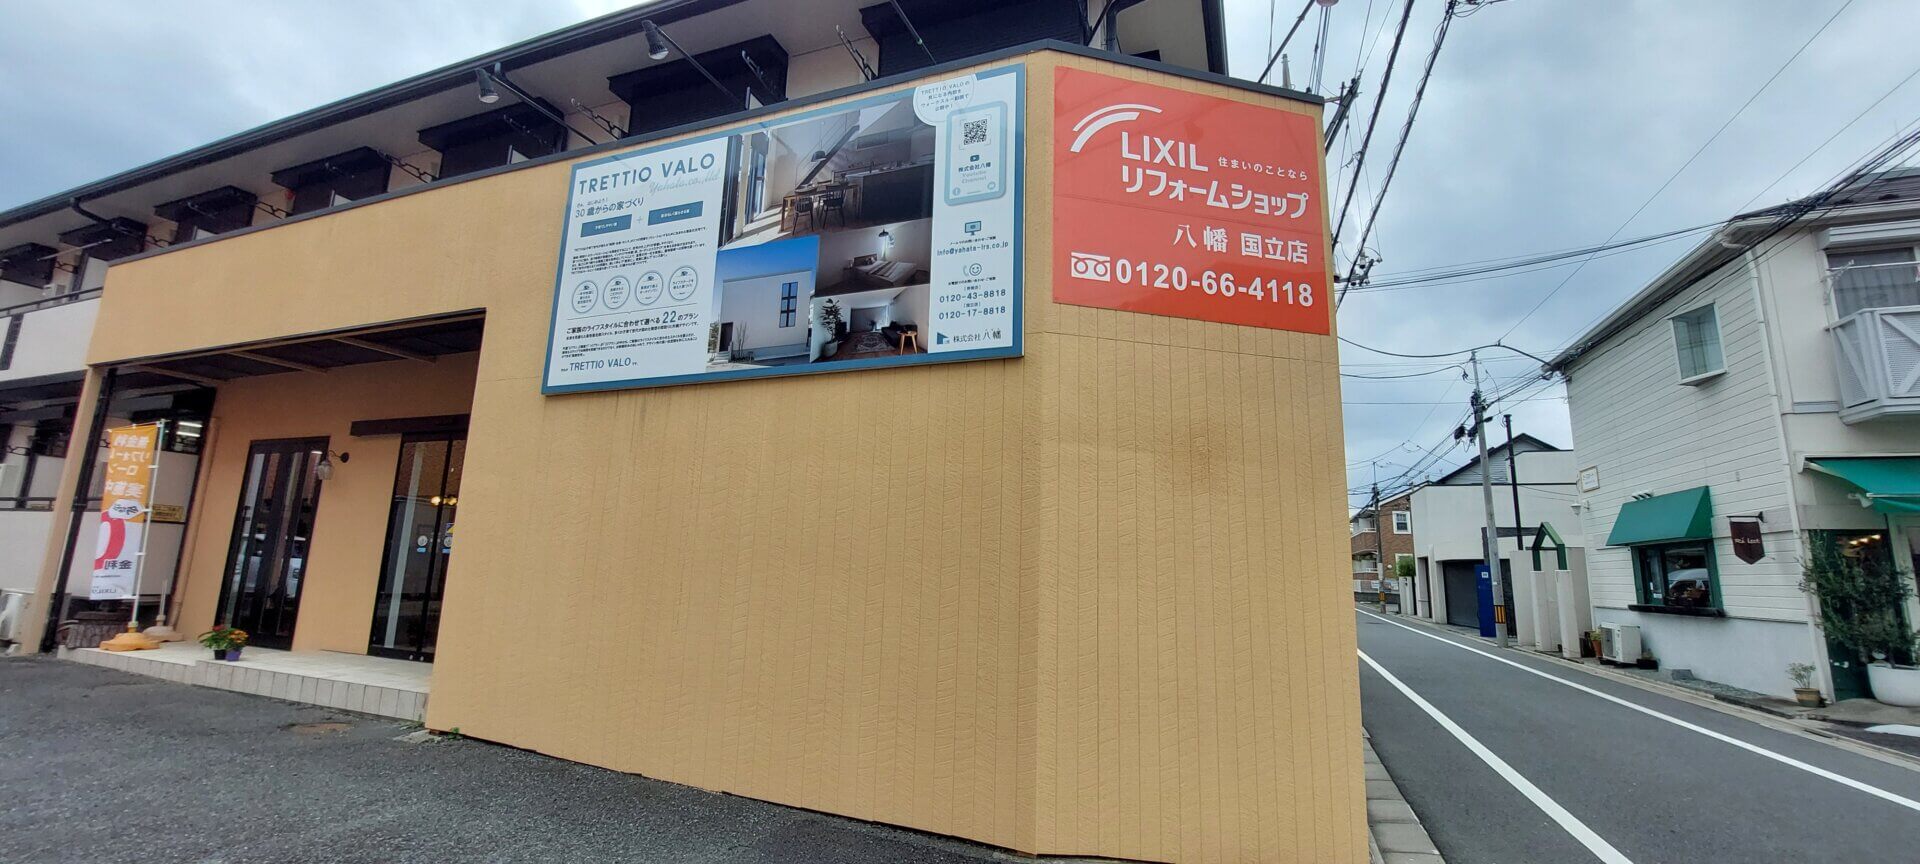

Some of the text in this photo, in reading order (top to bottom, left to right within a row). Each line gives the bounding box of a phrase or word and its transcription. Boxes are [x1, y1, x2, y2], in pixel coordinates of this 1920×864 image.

[1121, 131, 1209, 172] LIXIL
[1218, 156, 1308, 181] 住まいのことなら
[579, 153, 715, 195] TRETTIO VALO
[1121, 165, 1309, 219] リフォームショップ
[1173, 224, 1308, 264] 八幡 国立店
[939, 289, 1006, 303] 0120-43-8818
[1115, 258, 1314, 307] 0120-66-4118
[938, 306, 1006, 320] 0120-17-8818
[569, 360, 604, 372] TRETTIO
[607, 357, 632, 368] VALO
